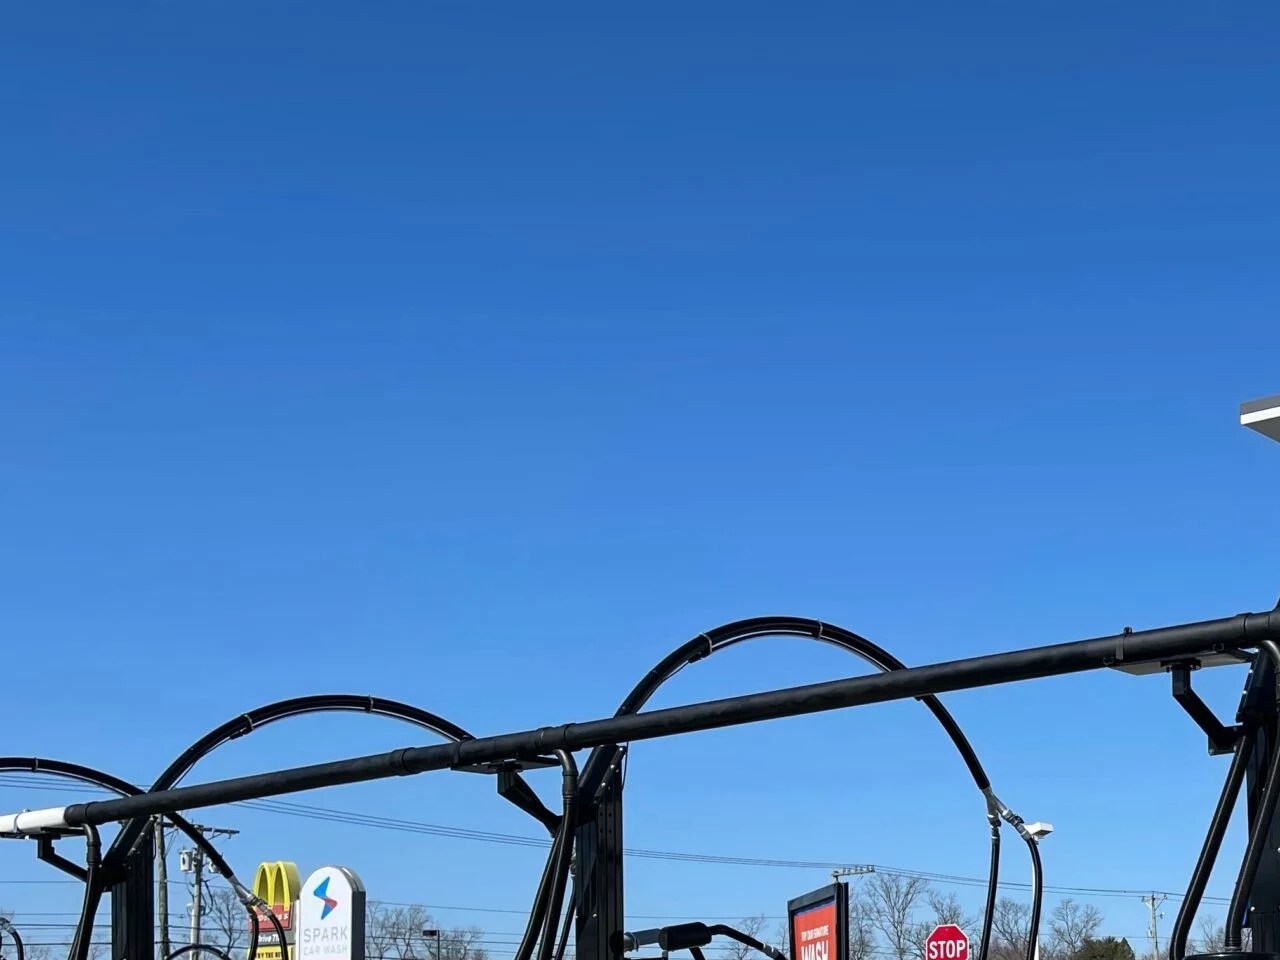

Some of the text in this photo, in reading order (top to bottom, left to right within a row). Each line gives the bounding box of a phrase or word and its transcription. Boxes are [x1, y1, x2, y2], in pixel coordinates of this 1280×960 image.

[303, 926, 348, 943] SPARK
[323, 943, 348, 955] WASH
[928, 939, 966, 959] STOP
